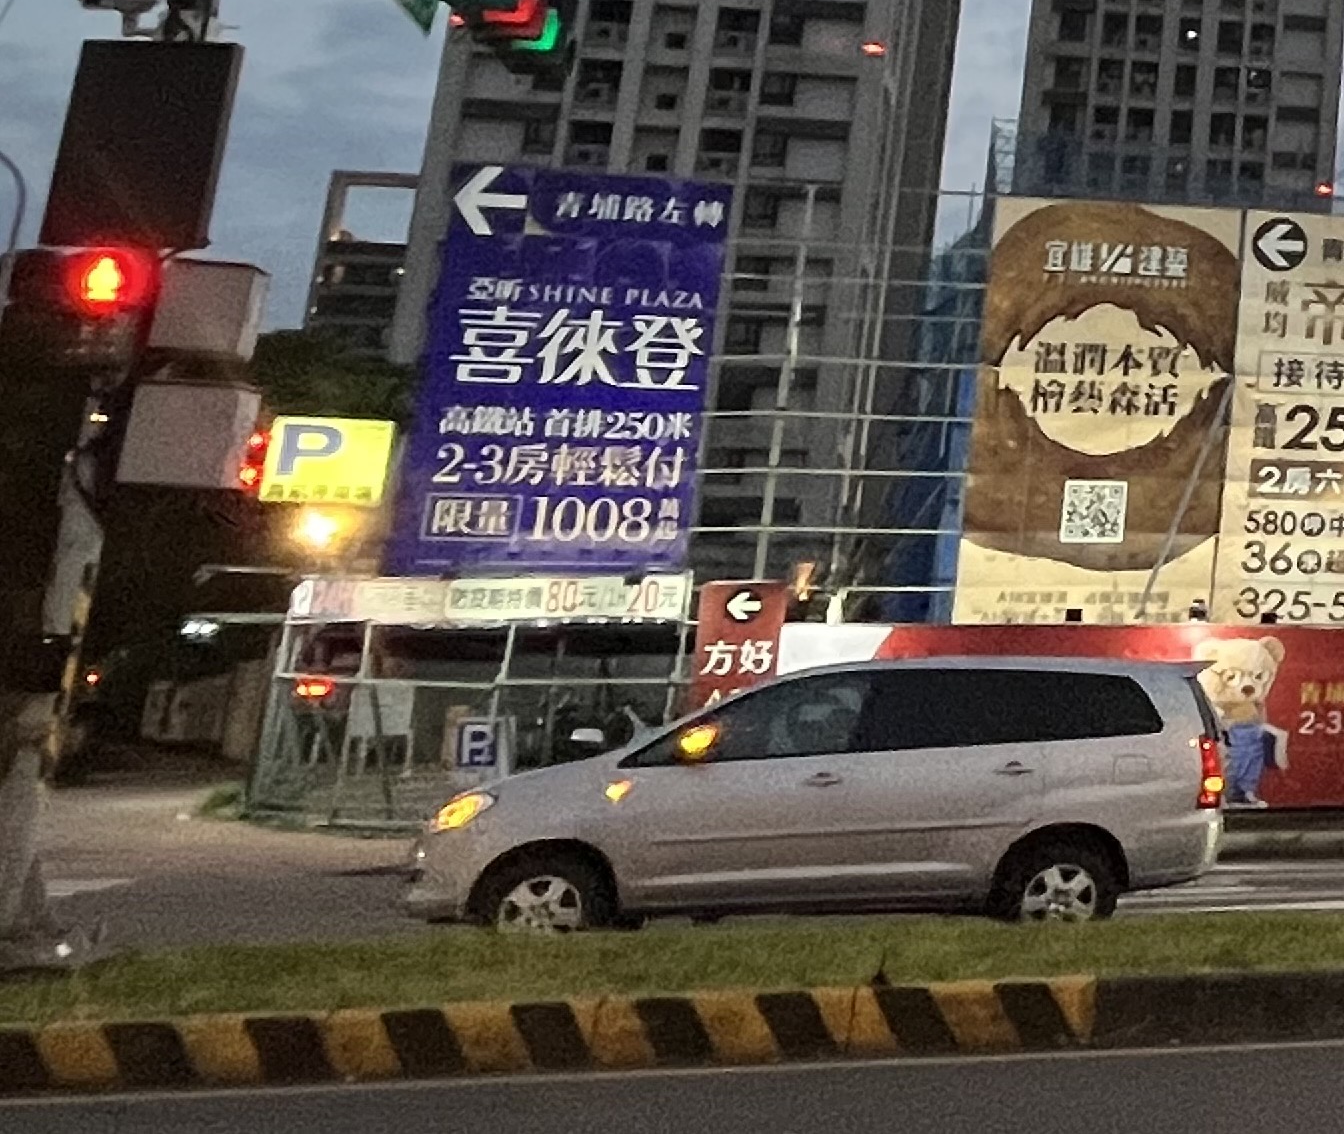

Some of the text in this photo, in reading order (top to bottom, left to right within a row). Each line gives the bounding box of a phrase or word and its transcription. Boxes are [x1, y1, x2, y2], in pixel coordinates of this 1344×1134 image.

[556, 191, 725, 227] 青埔路左轉
[529, 284, 613, 304] SHINE
[624, 287, 703, 309] PLAZA
[449, 306, 704, 391] 喜徠登
[277, 424, 342, 475] P
[432, 442, 687, 489] 2-3房輕鬆付
[701, 639, 774, 676] 方好
